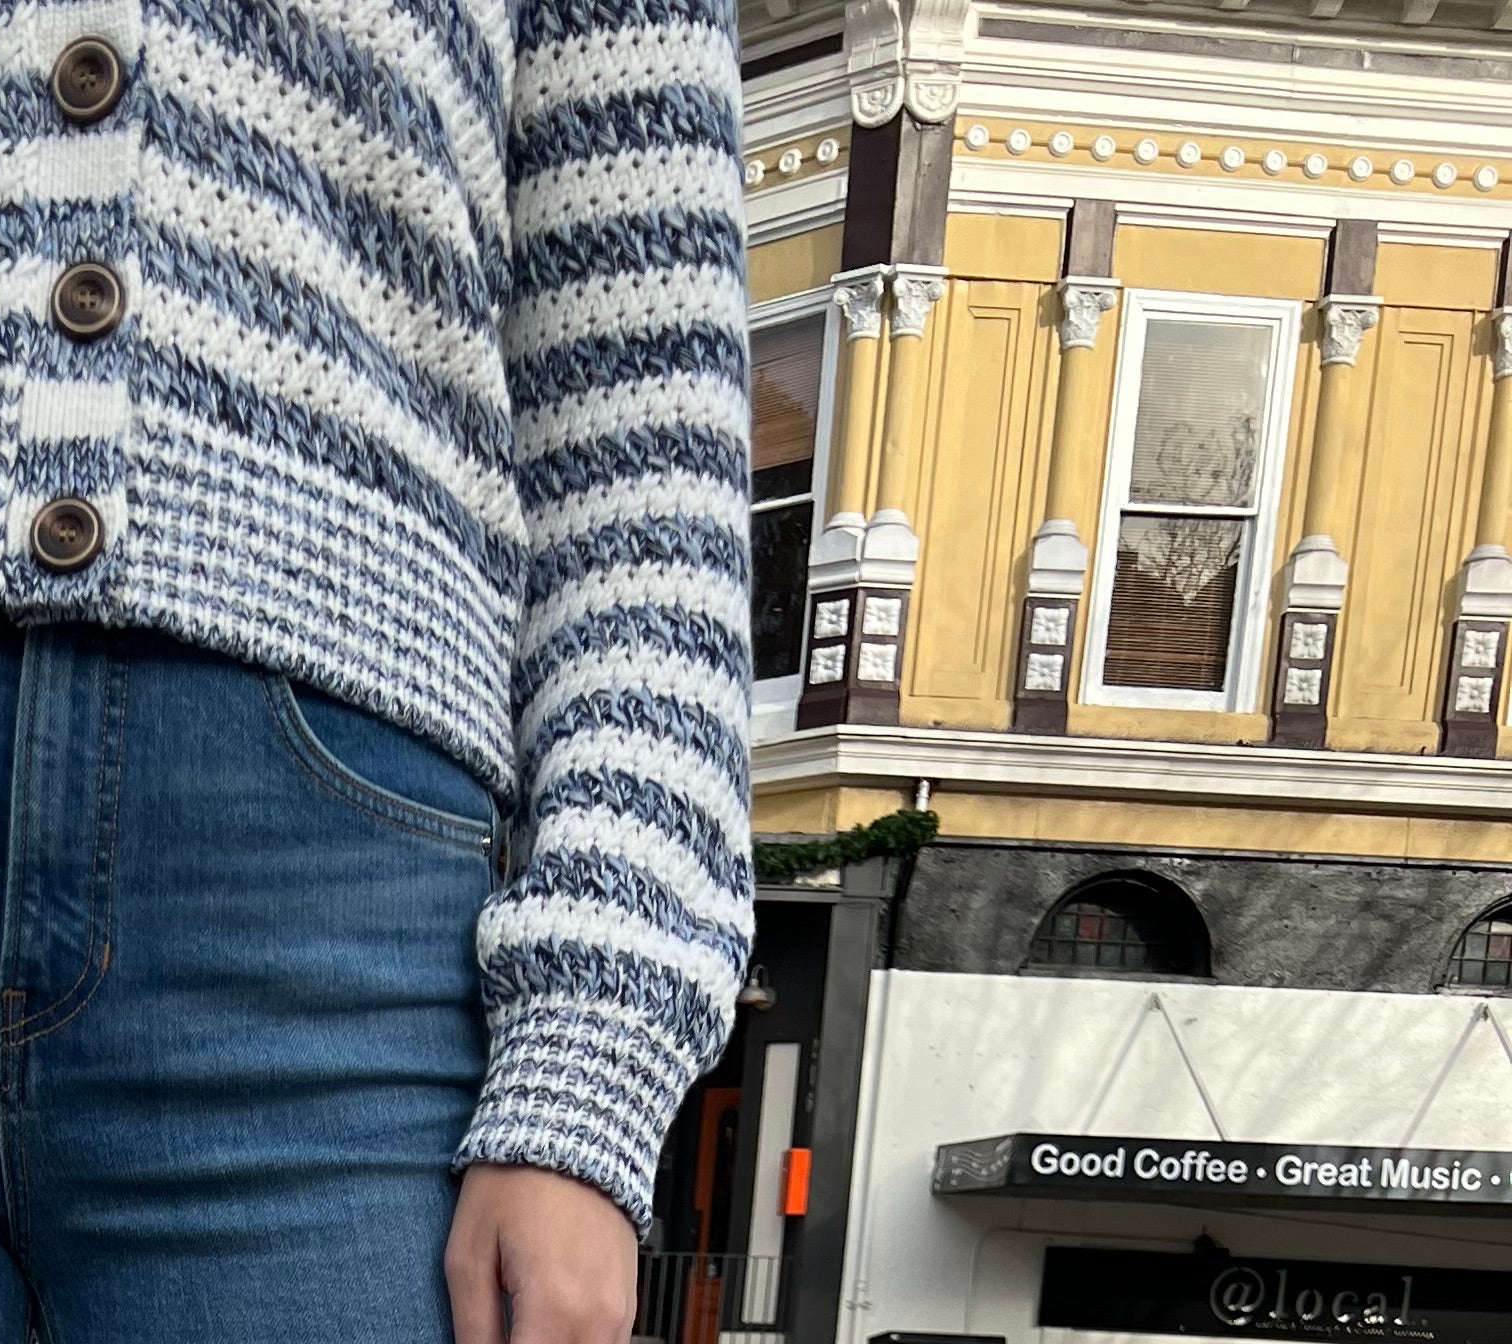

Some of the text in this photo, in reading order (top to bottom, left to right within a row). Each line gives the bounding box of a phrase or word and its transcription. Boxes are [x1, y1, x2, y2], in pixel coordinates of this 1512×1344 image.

[1031, 1143, 1126, 1179] Good
[1133, 1148, 1249, 1184] Coffee
[1275, 1155, 1373, 1188] Great
[1380, 1158, 1482, 1191] Music
